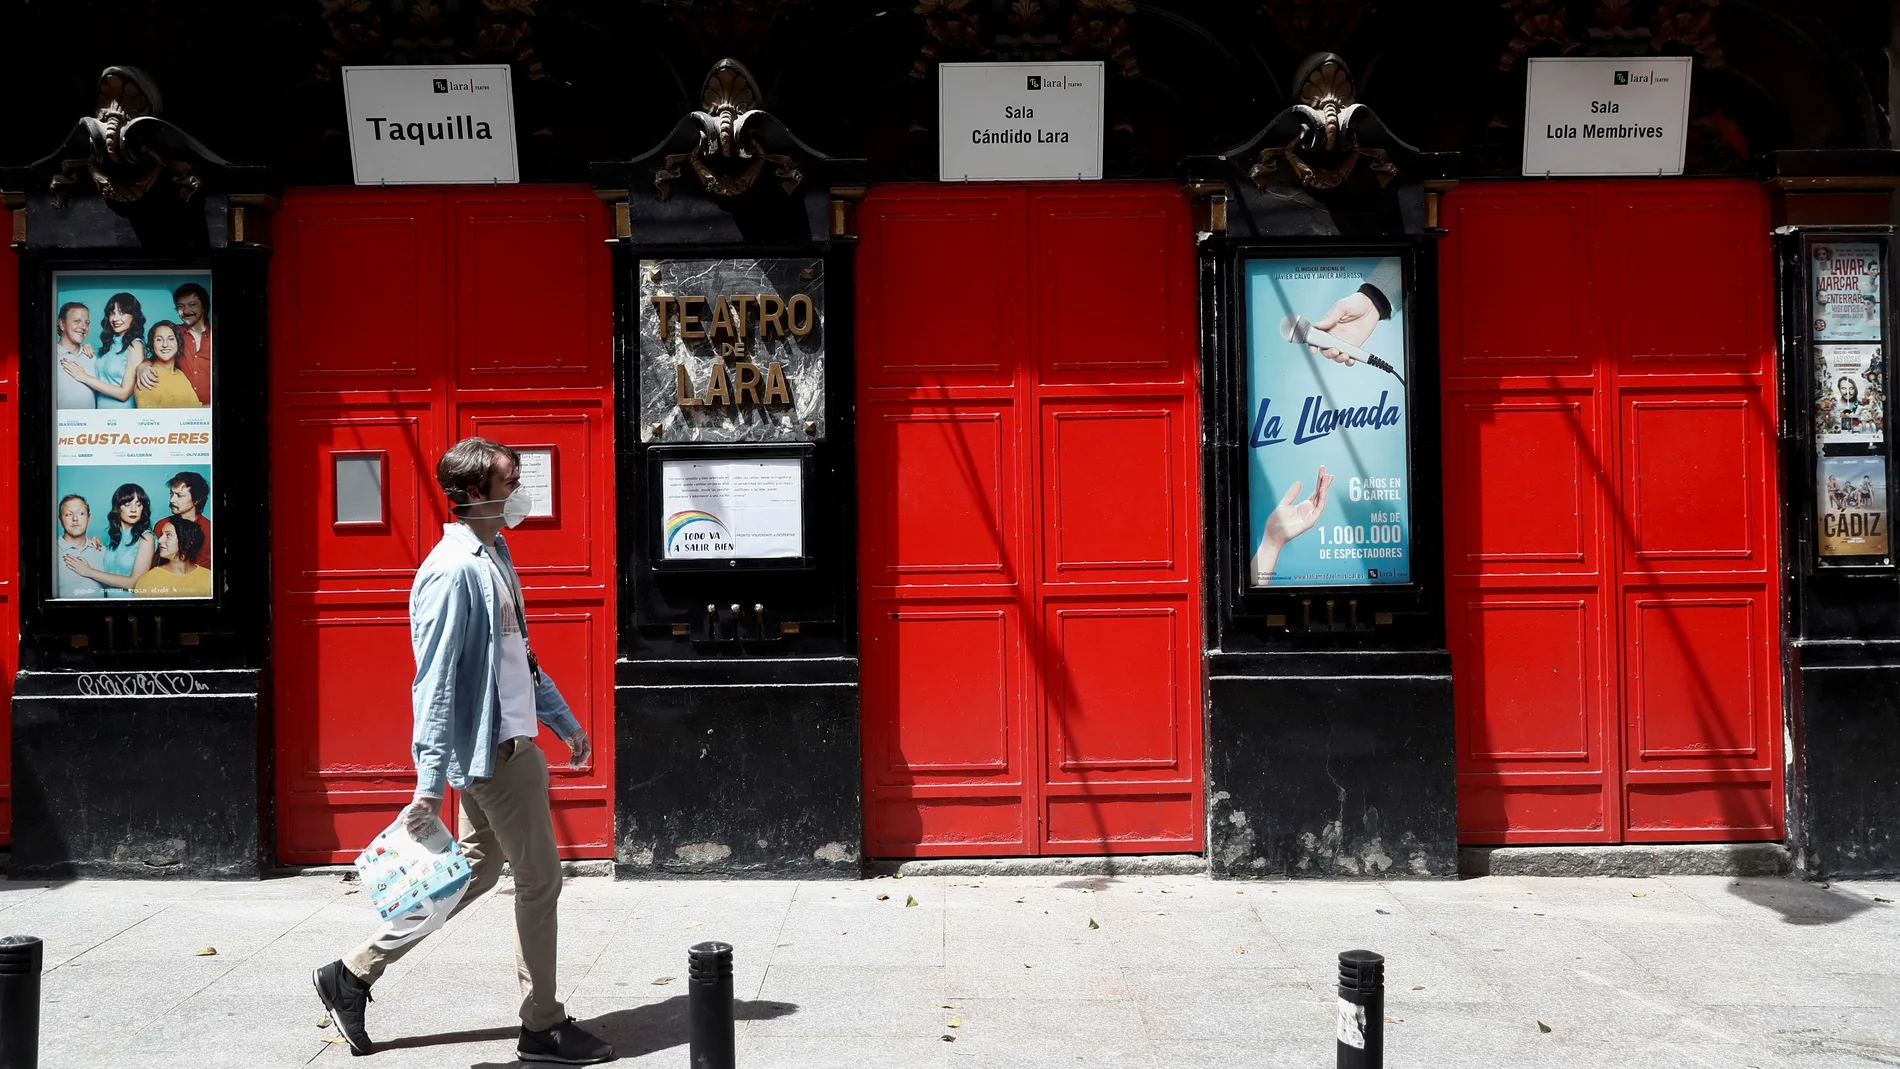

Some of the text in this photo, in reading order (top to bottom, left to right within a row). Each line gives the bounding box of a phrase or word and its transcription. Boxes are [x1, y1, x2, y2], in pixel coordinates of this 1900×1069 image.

[1043, 78, 1062, 87] lara
[1630, 74, 1649, 82] lara
[449, 81, 469, 91] lara
[1005, 106, 1034, 118] Sala
[1590, 100, 1620, 113] Sala
[366, 115, 492, 145] Taquilla
[972, 129, 1069, 144] Cándido Lara
[1547, 124, 1663, 139] Lola Membrives
[1816, 276, 1859, 290] MARCAR
[650, 294, 813, 338] TEATRO
[721, 342, 745, 357] DE
[676, 362, 790, 406] LARA
[1250, 390, 1402, 448] La Llamada
[58, 432, 210, 445] ME GUSTA COMO ERES
[1349, 476, 1401, 502] 6 AÑOS EN
[1363, 489, 1401, 501] CARTEL
[1370, 510, 1401, 523] MÁS DE
[683, 531, 721, 541] TODO VA
[1318, 524, 1401, 545] 1.000.000
[674, 542, 734, 553] A SALIR BIEN
[1319, 548, 1403, 559] DE ESPECTADORES
